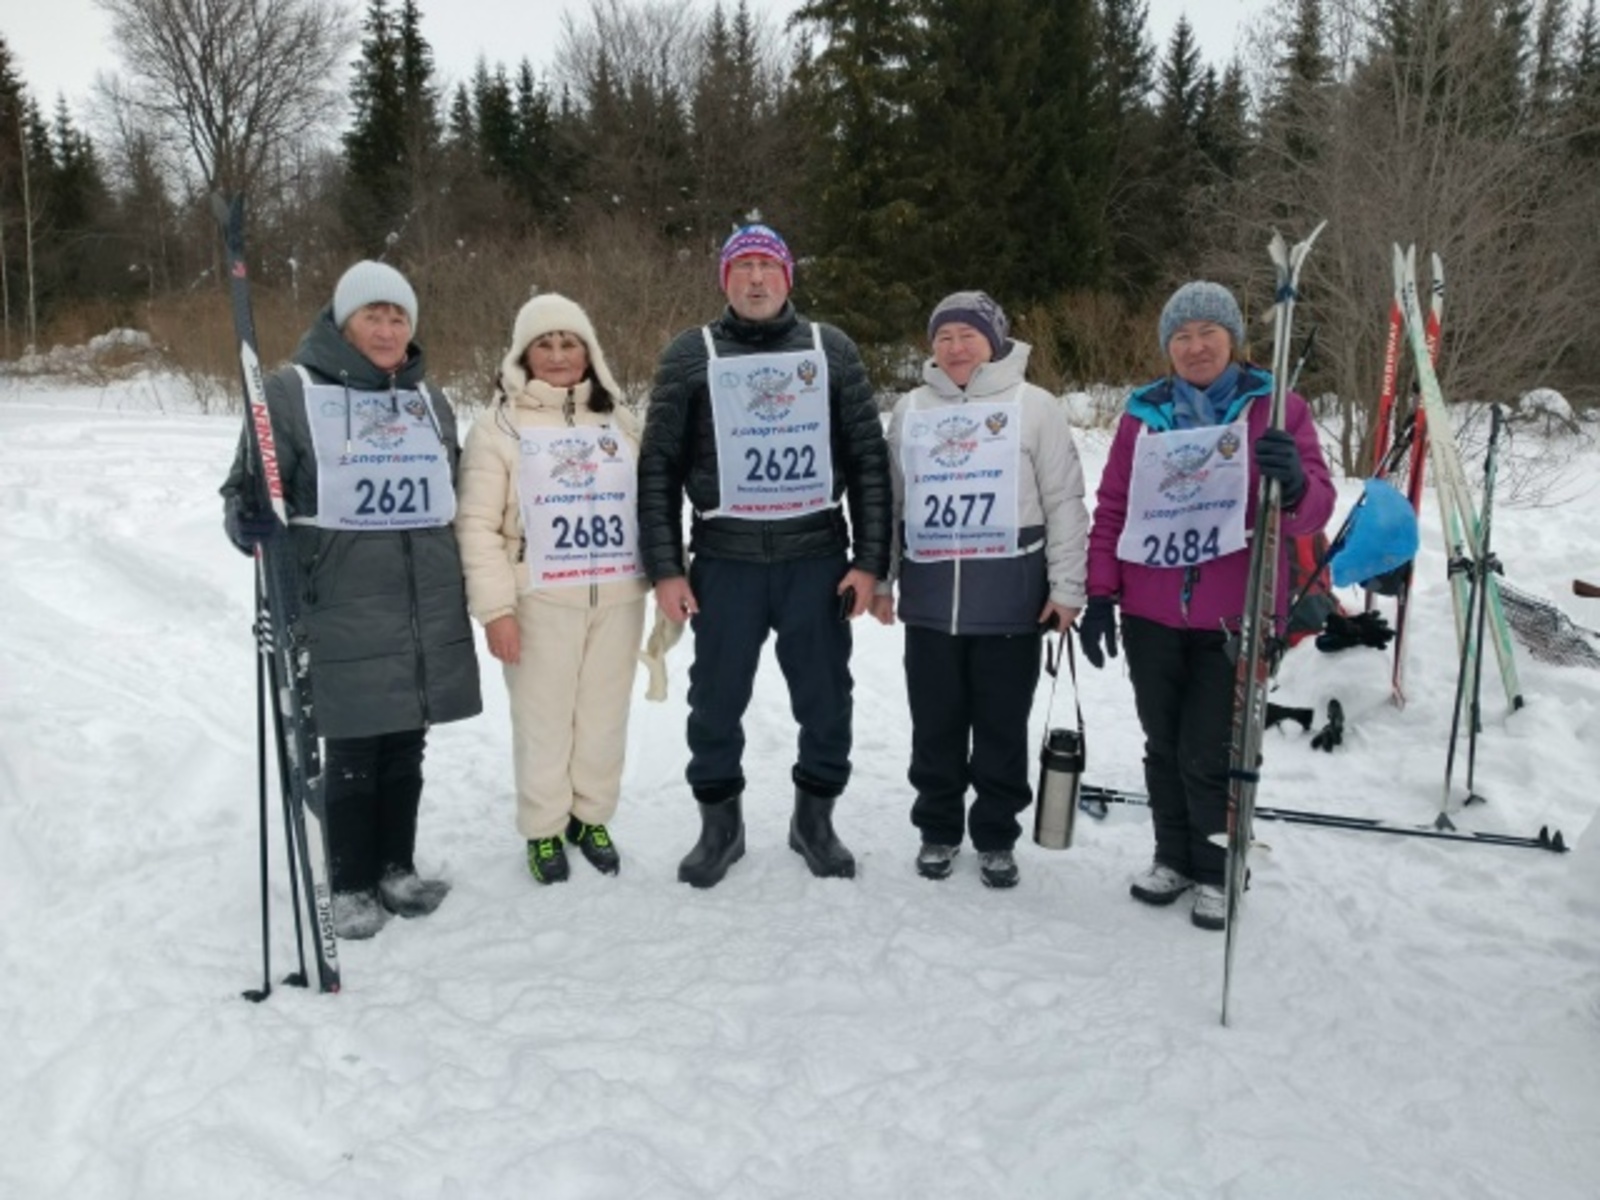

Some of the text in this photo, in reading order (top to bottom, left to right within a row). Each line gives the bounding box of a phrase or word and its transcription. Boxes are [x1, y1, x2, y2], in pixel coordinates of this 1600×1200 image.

[744, 445, 817, 481] 2622
[355, 477, 430, 515] 2621
[924, 492, 996, 528] 2677
[552, 514, 624, 548] 2683
[1143, 526, 1221, 566] 2684
[318, 901, 338, 958] CLASSIC
